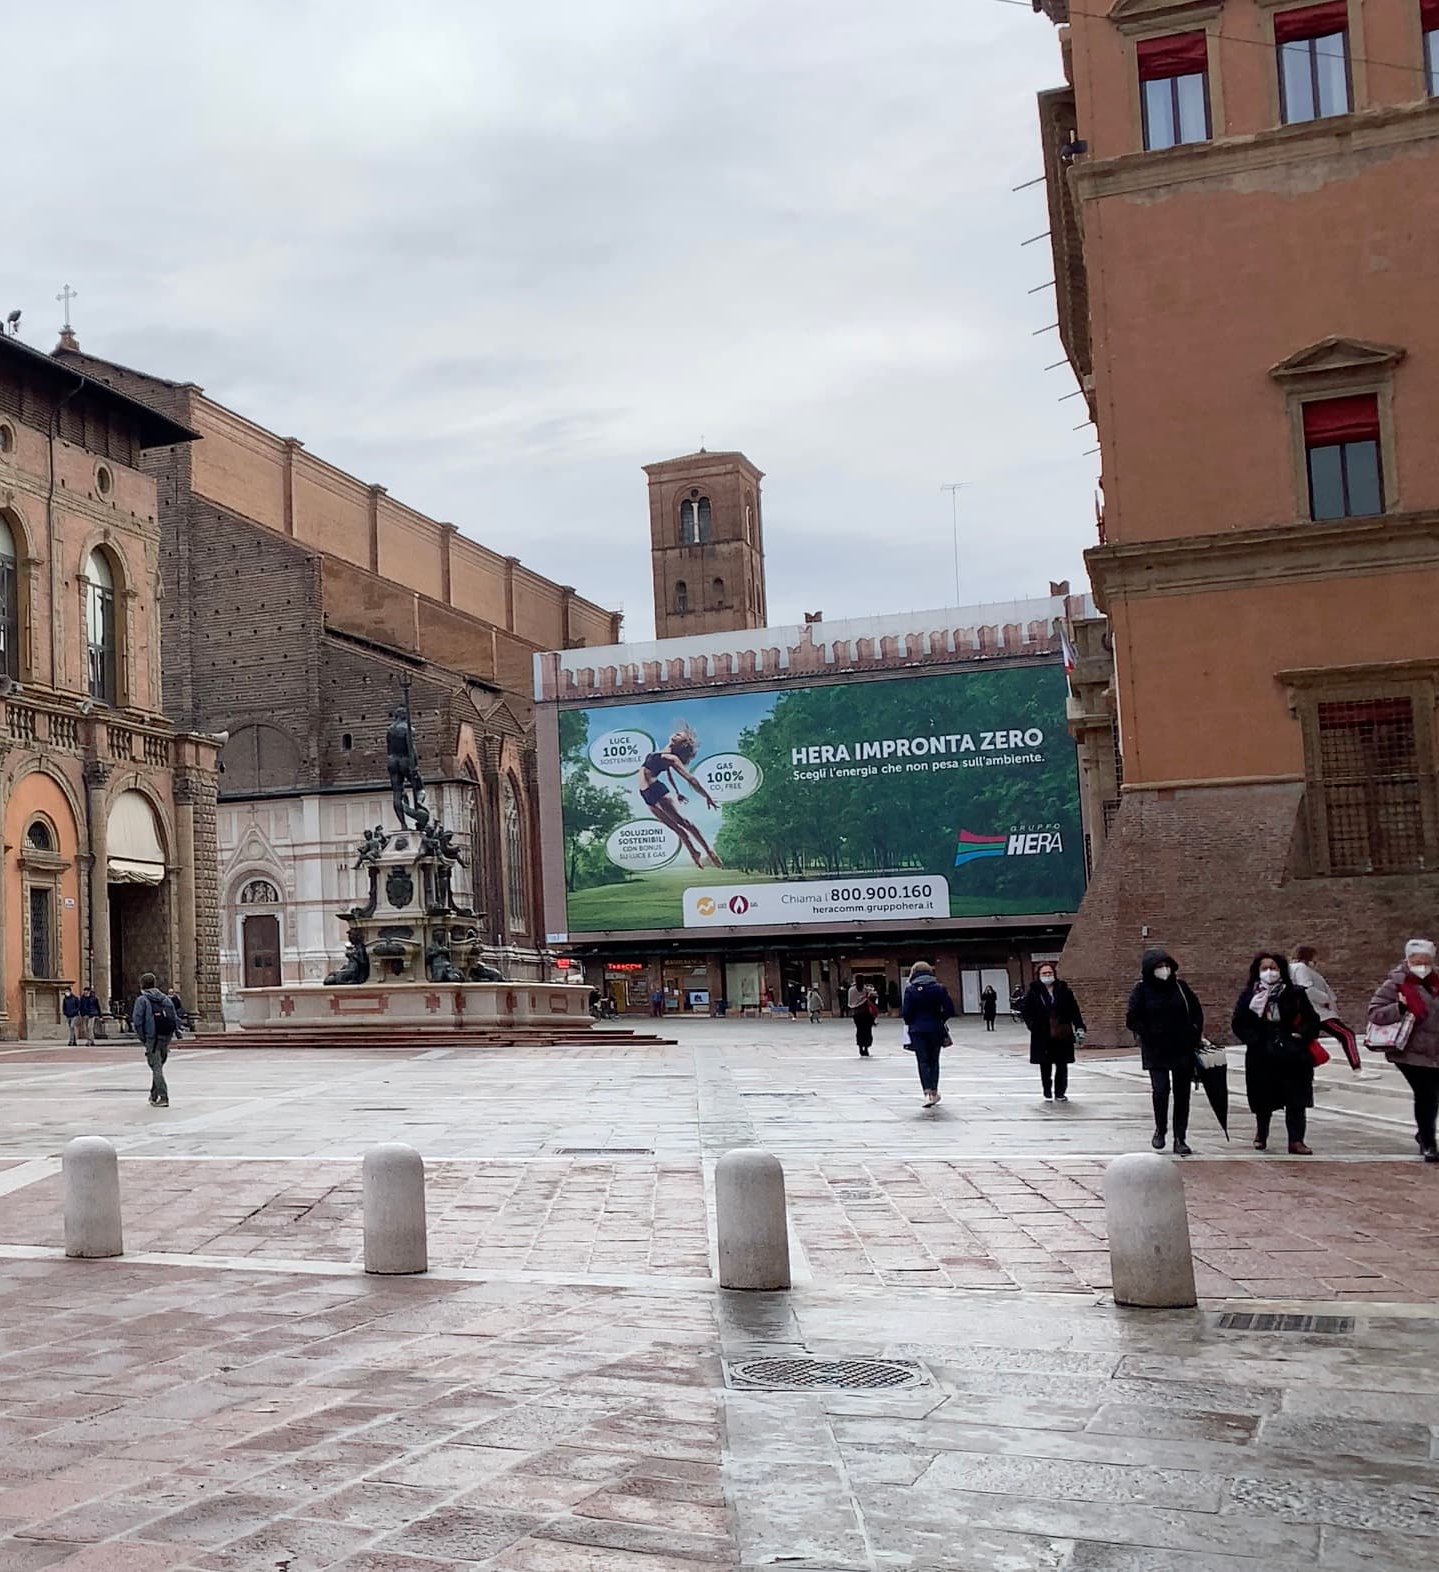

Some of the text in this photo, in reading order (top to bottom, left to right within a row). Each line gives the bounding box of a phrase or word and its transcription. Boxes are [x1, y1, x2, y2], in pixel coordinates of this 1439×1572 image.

[609, 737, 631, 745] LUCE
[603, 745, 639, 757] 100%
[792, 728, 1044, 765] HERA IMPRONTA ZERO
[600, 756, 642, 766] SOSTENIBILE
[716, 762, 733, 770] GAS
[793, 752, 1046, 782] Scegli l'energia che non pesa sull'ambiente.
[707, 770, 744, 783] 100%
[725, 782, 742, 790] FREE
[620, 828, 663, 837] SOLUZIONI
[1010, 823, 1061, 832] GRUPPO
[618, 836, 666, 845] SOSTENIBILI
[1007, 832, 1063, 855] HERA
[781, 894, 822, 904] Chiama
[812, 901, 934, 915] heracomm.gruppohera.it
